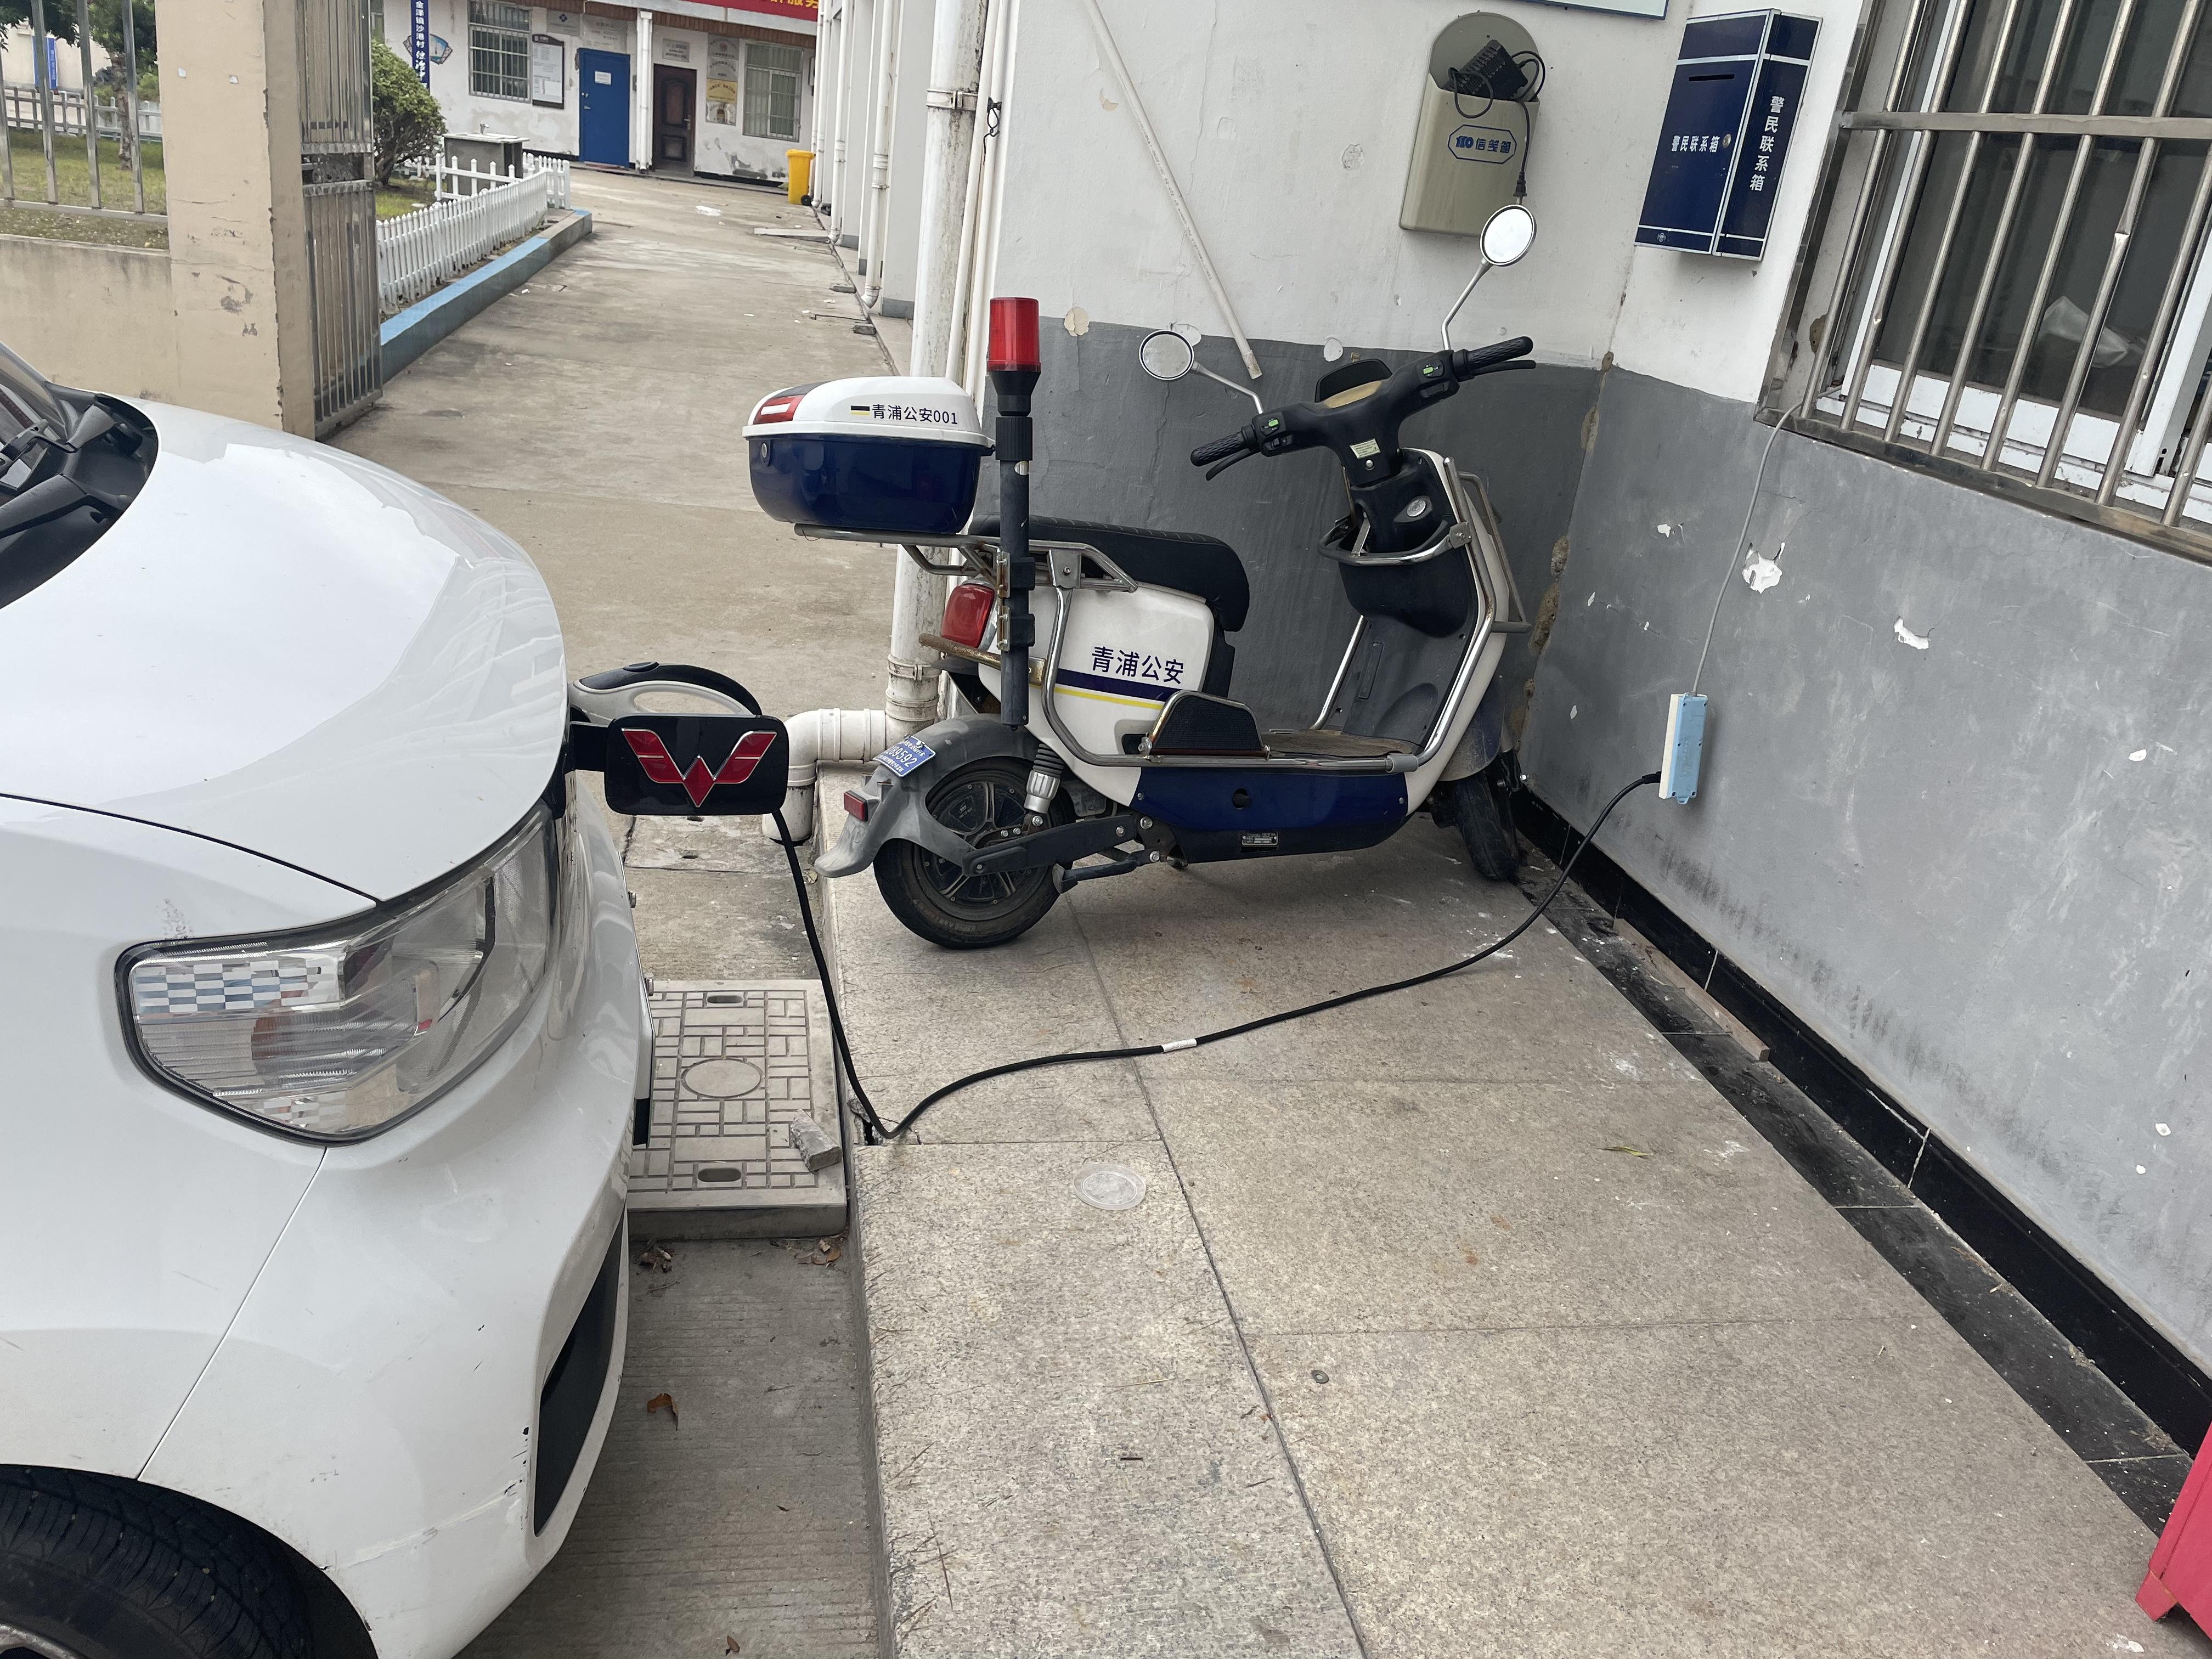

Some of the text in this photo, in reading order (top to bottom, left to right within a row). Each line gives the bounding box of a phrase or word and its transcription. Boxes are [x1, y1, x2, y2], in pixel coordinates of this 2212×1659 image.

[1672, 136, 1720, 153] 警民联系箱
[1750, 95, 1785, 191] 警民联系箱
[872, 404, 958, 425] 青浦公安001
[1092, 646, 1183, 684] 青浦公安
